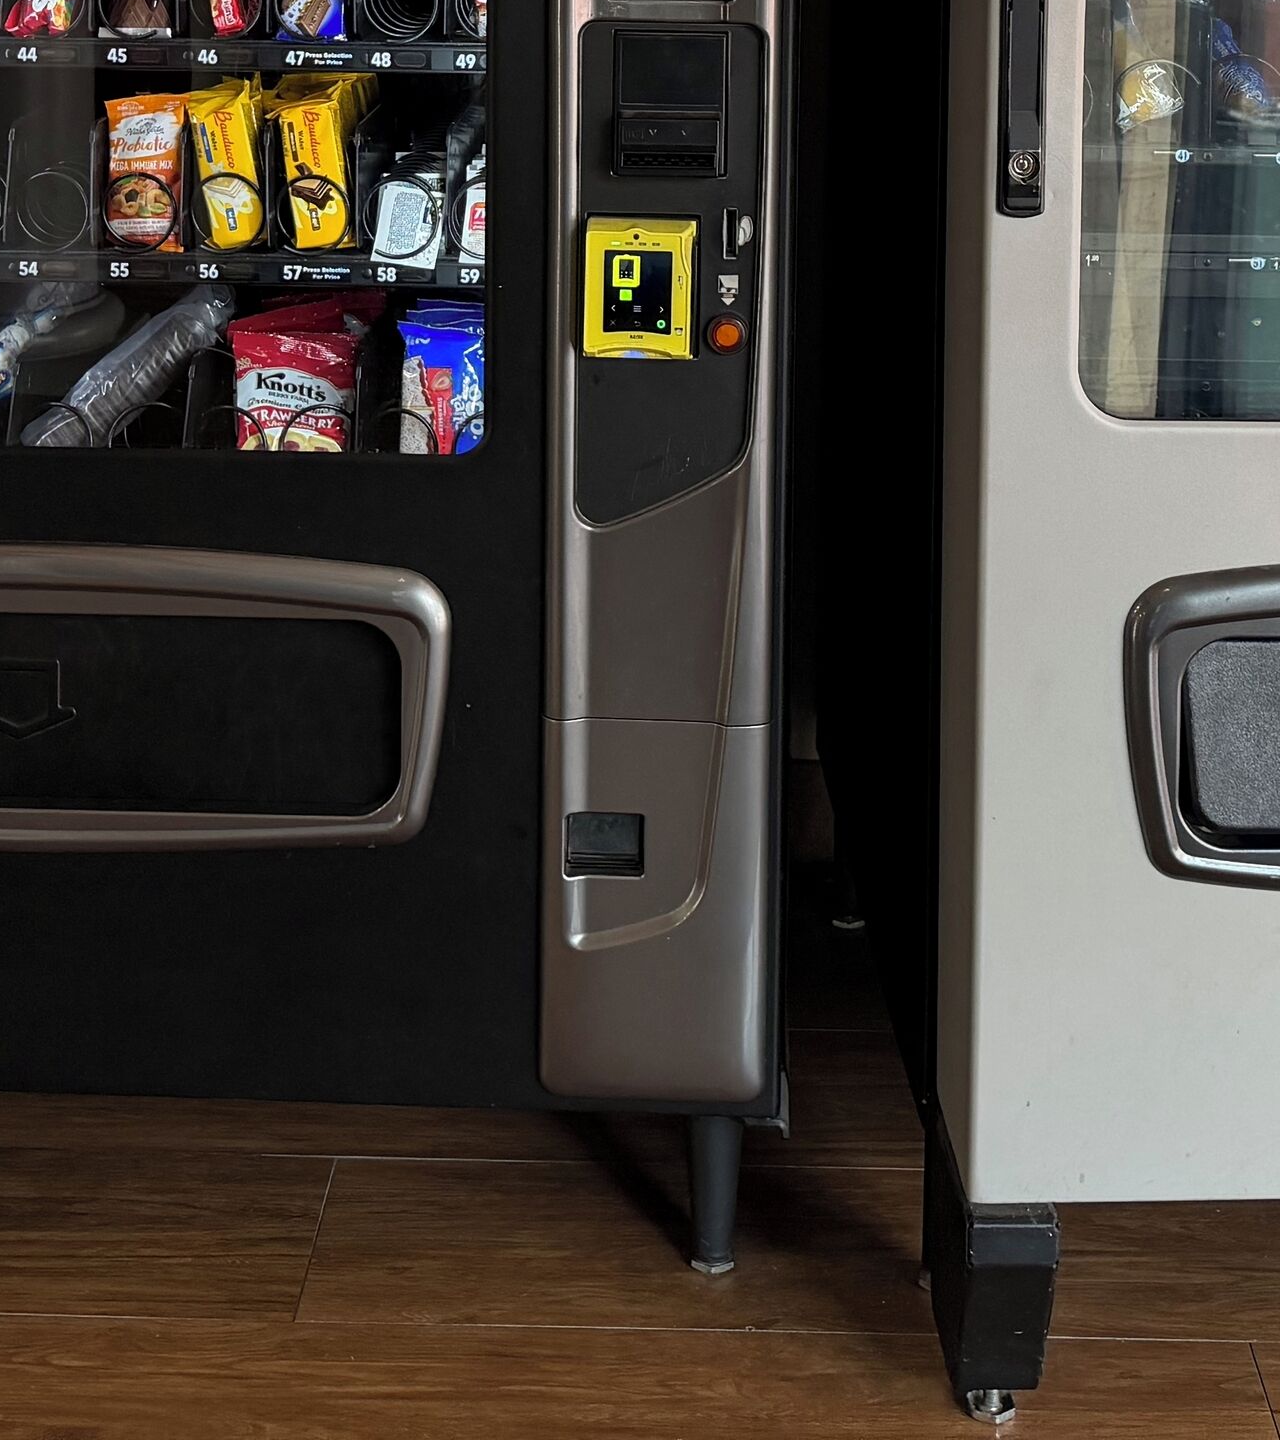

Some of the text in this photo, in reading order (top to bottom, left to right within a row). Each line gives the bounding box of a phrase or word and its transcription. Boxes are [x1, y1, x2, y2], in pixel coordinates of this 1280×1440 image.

[18, 47, 37, 61] 44
[108, 48, 126, 62] 45
[198, 50, 217, 64] 46
[286, 51, 304, 65] 47
[371, 52, 391, 67] 48
[456, 54, 476, 68] 49
[112, 137, 173, 154] Probiotic
[213, 110, 236, 169] Bauducco
[302, 109, 321, 169] Bauducco
[110, 160, 174, 171] MEGA IMMUNE MIX
[19, 262, 38, 275] 54
[111, 263, 129, 277] 55
[200, 264, 218, 278] 56
[284, 265, 302, 279] 57
[378, 267, 396, 281] 58
[461, 269, 479, 283] 59
[255, 371, 327, 403] Knott's
